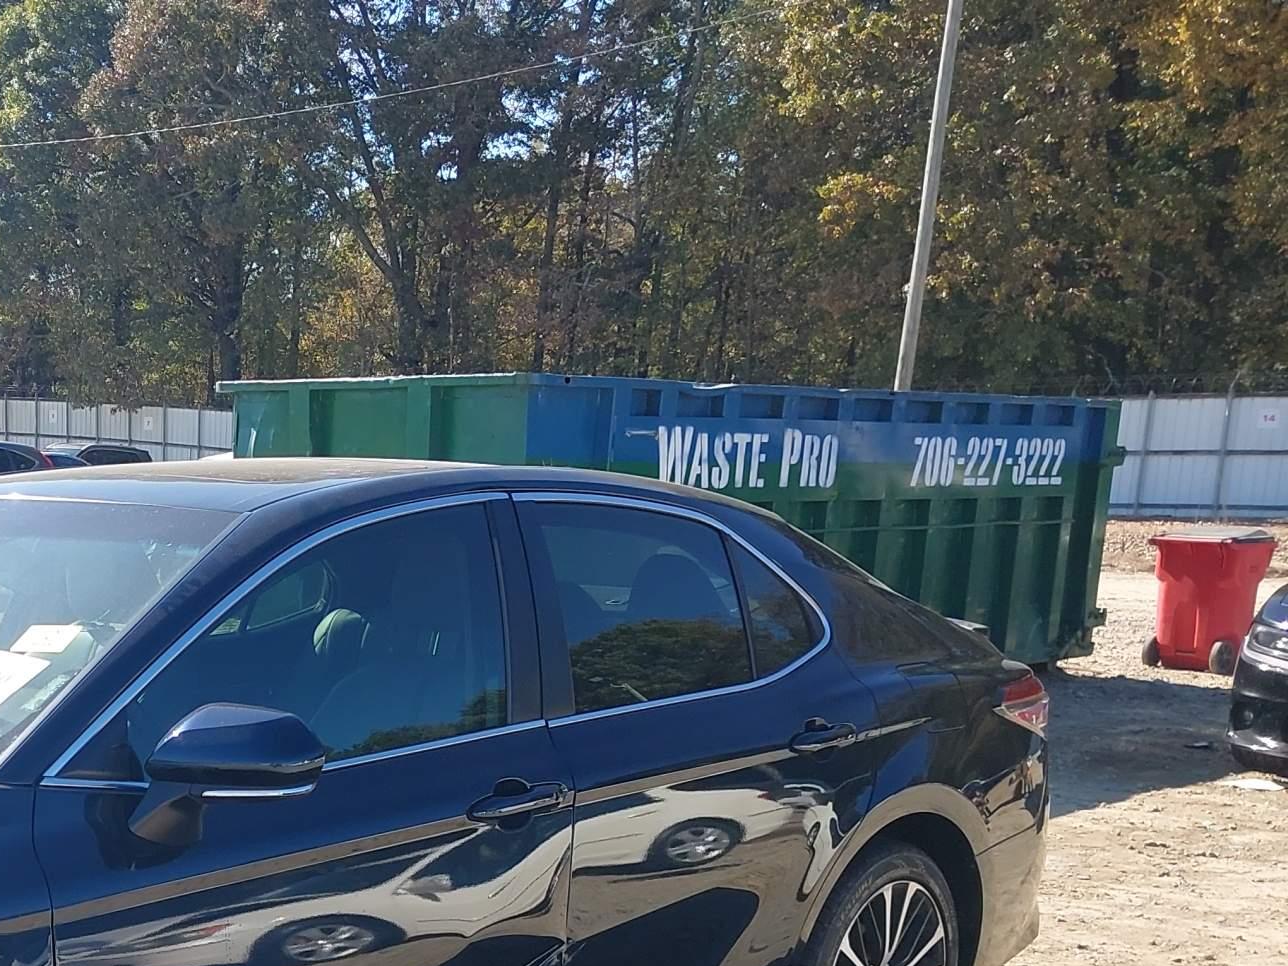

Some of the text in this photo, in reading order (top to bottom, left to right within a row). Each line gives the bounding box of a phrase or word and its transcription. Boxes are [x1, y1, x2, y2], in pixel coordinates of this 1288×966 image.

[658, 425, 839, 488] WASTE PRO
[910, 436, 1066, 488] 706-227-3222
